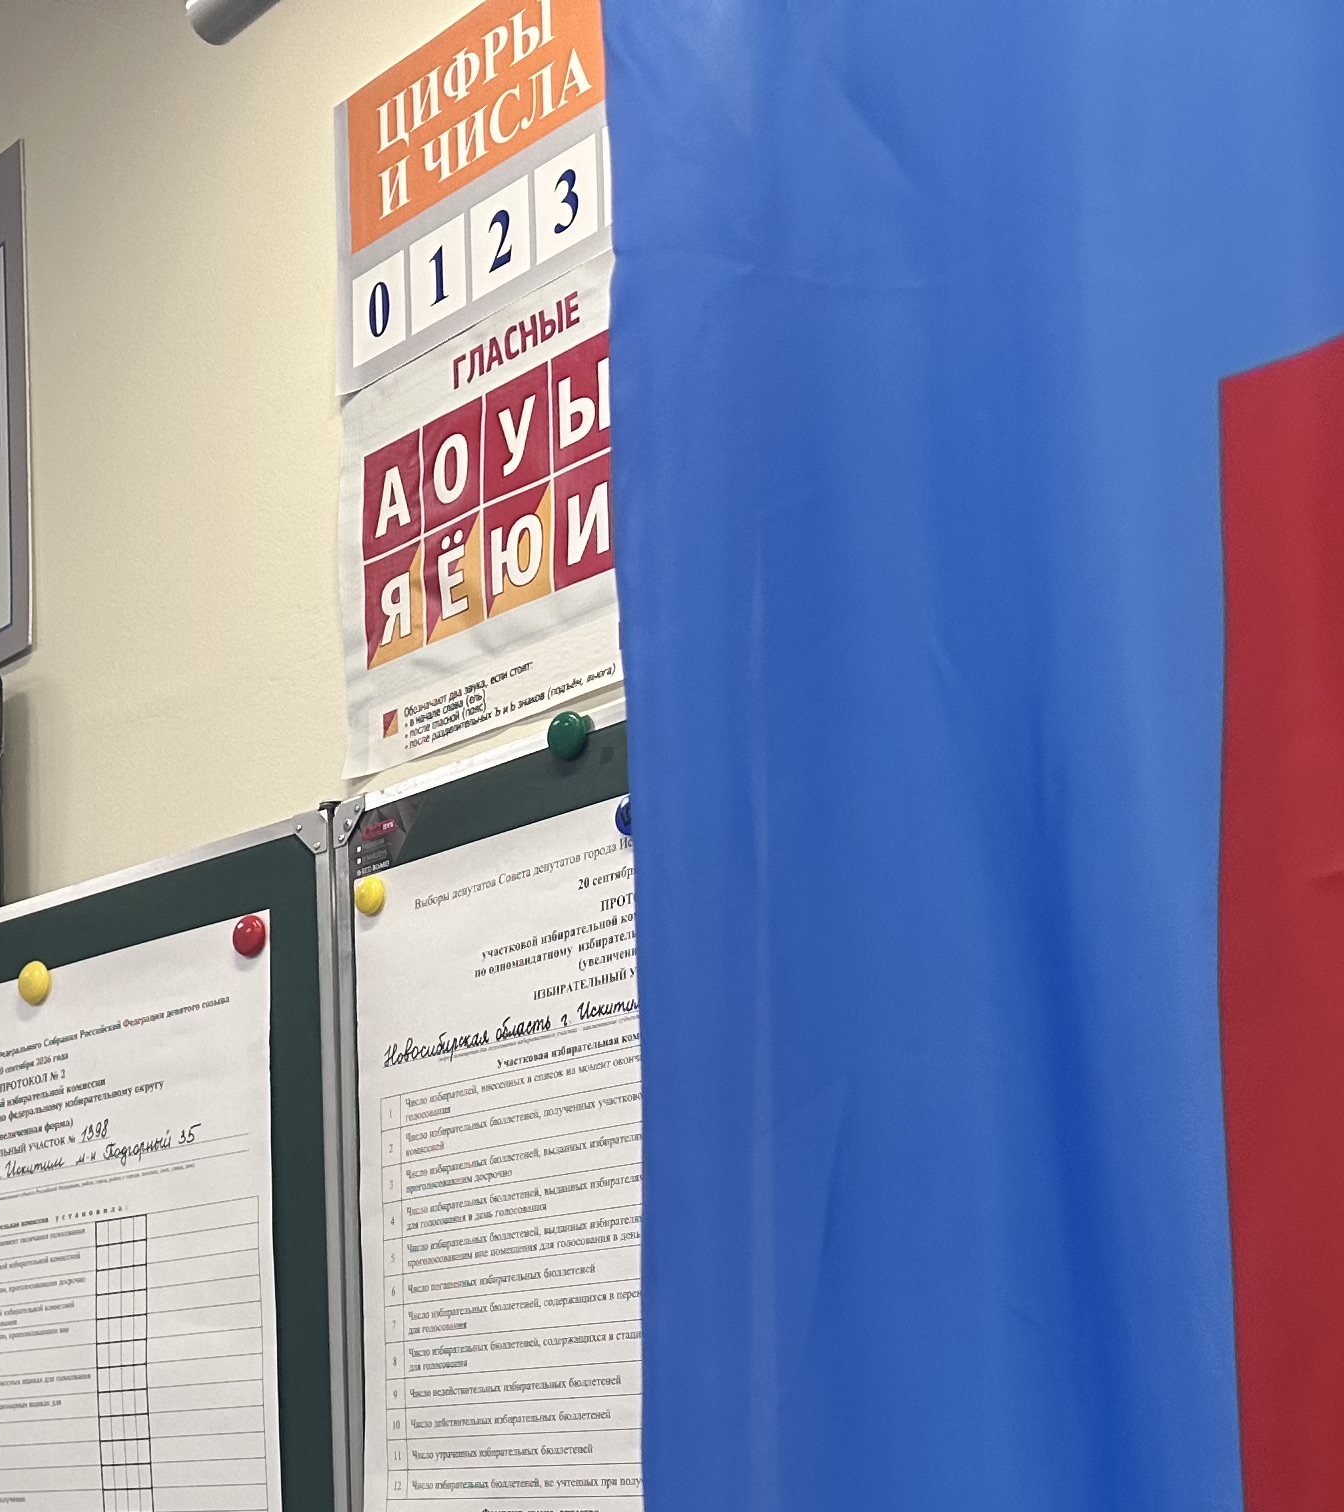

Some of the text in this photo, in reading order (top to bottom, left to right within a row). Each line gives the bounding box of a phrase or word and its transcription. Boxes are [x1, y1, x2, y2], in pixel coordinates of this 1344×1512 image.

[377, 0, 555, 154] ЦИФРЫ
[378, 48, 592, 221] И ЧИСЛА
[369, 169, 579, 338] 0 1 2 3
[453, 291, 580, 390] ГЛАСНЫЕ
[375, 358, 611, 538] А О У Ы
[379, 481, 610, 647] Я Ё Ю И
[490, 671, 508, 685] если
[414, 843, 617, 910] Выборы депутатов Совета депутатов города
[578, 877, 589, 890] 20
[600, 893, 635, 912] ПРОТ
[474, 930, 636, 978] по одномандатному избиратель
[481, 916, 618, 961] участковой избирательной
[533, 969, 626, 1001] ИЗБИРАТЕЛЬНЫЙ
[383, 1029, 489, 1067] Новосибирская
[495, 1016, 551, 1042] область
[0, 1073, 48, 1093] ПРОТОКОЛ
[4, 1156, 64, 1177] Искитим
[103, 1128, 172, 1166] Подгорный
[178, 1123, 202, 1145] 35
[29, 1136, 66, 1155] УЧАСТОК
[80, 1119, 109, 1143] 1398
